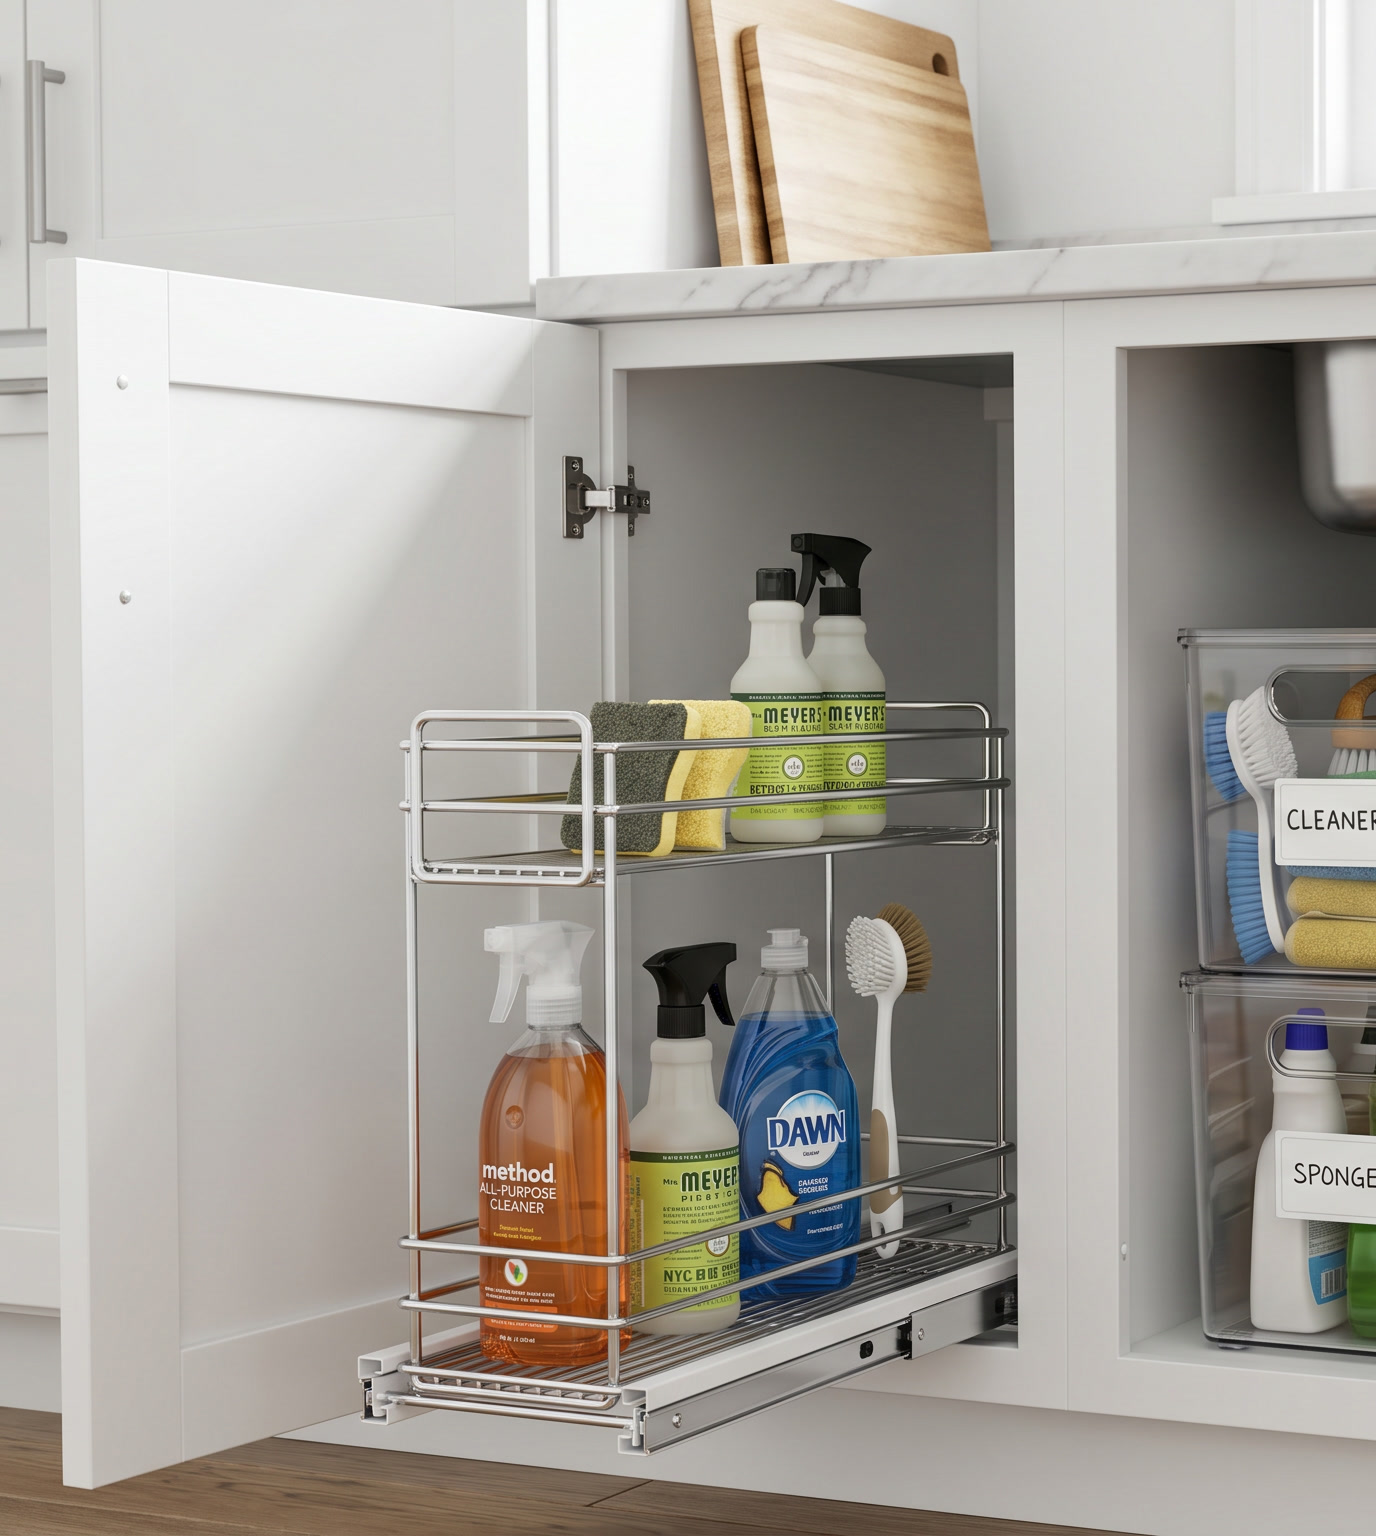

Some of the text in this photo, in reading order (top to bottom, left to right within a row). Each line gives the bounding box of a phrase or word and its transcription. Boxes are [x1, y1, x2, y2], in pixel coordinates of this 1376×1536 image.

[828, 705, 885, 722] MEYER'S
[768, 1111, 846, 1149] DAWN
[681, 1165, 739, 1192] MEYER
[480, 1182, 557, 1200] ALL-PURPOSE
[490, 1198, 545, 1214] CLEANER
[663, 1269, 693, 1283] NYC
